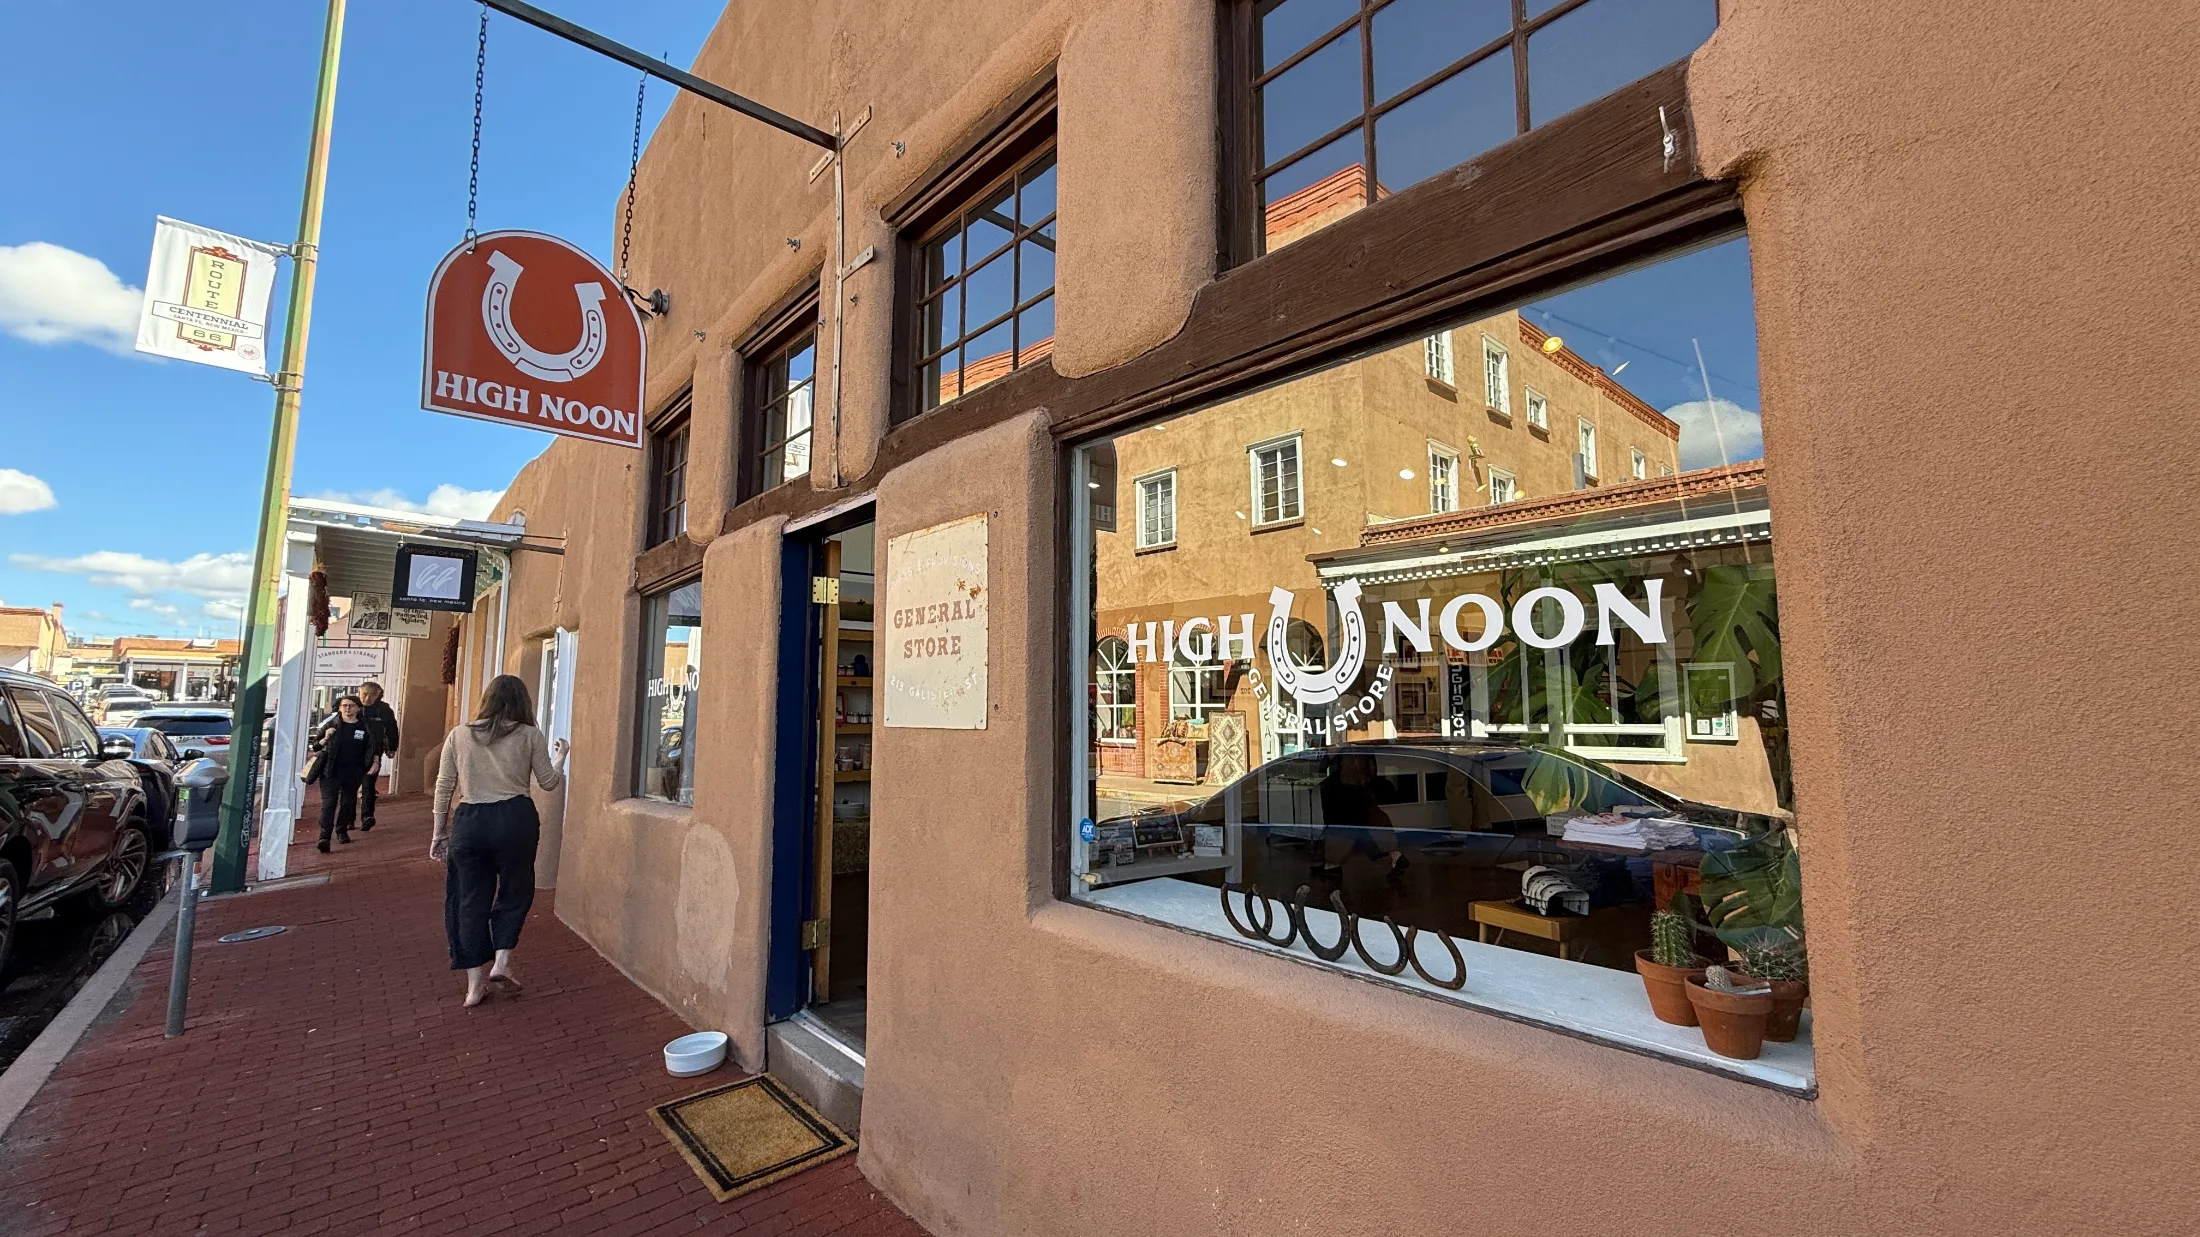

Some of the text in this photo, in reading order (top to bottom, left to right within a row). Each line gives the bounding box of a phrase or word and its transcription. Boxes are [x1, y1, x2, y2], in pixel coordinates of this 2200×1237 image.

[204, 259, 225, 310] ROUTE
[169, 306, 249, 330] CENTENNIAL
[193, 329, 222, 342] 66
[435, 371, 635, 435] HIGH NOON
[894, 599, 977, 629] GENERAL
[1126, 578, 1667, 664] HIGH NOON
[318, 650, 347, 659] STANDARD
[353, 650, 377, 660] STRANGE
[903, 635, 962, 659] STORE
[72, 681, 83, 690] P
[648, 678, 669, 697] HIGH
[890, 675, 904, 692] 213
[1248, 663, 1394, 735] GENERAL STORE
[1081, 824, 1093, 834] ADT
